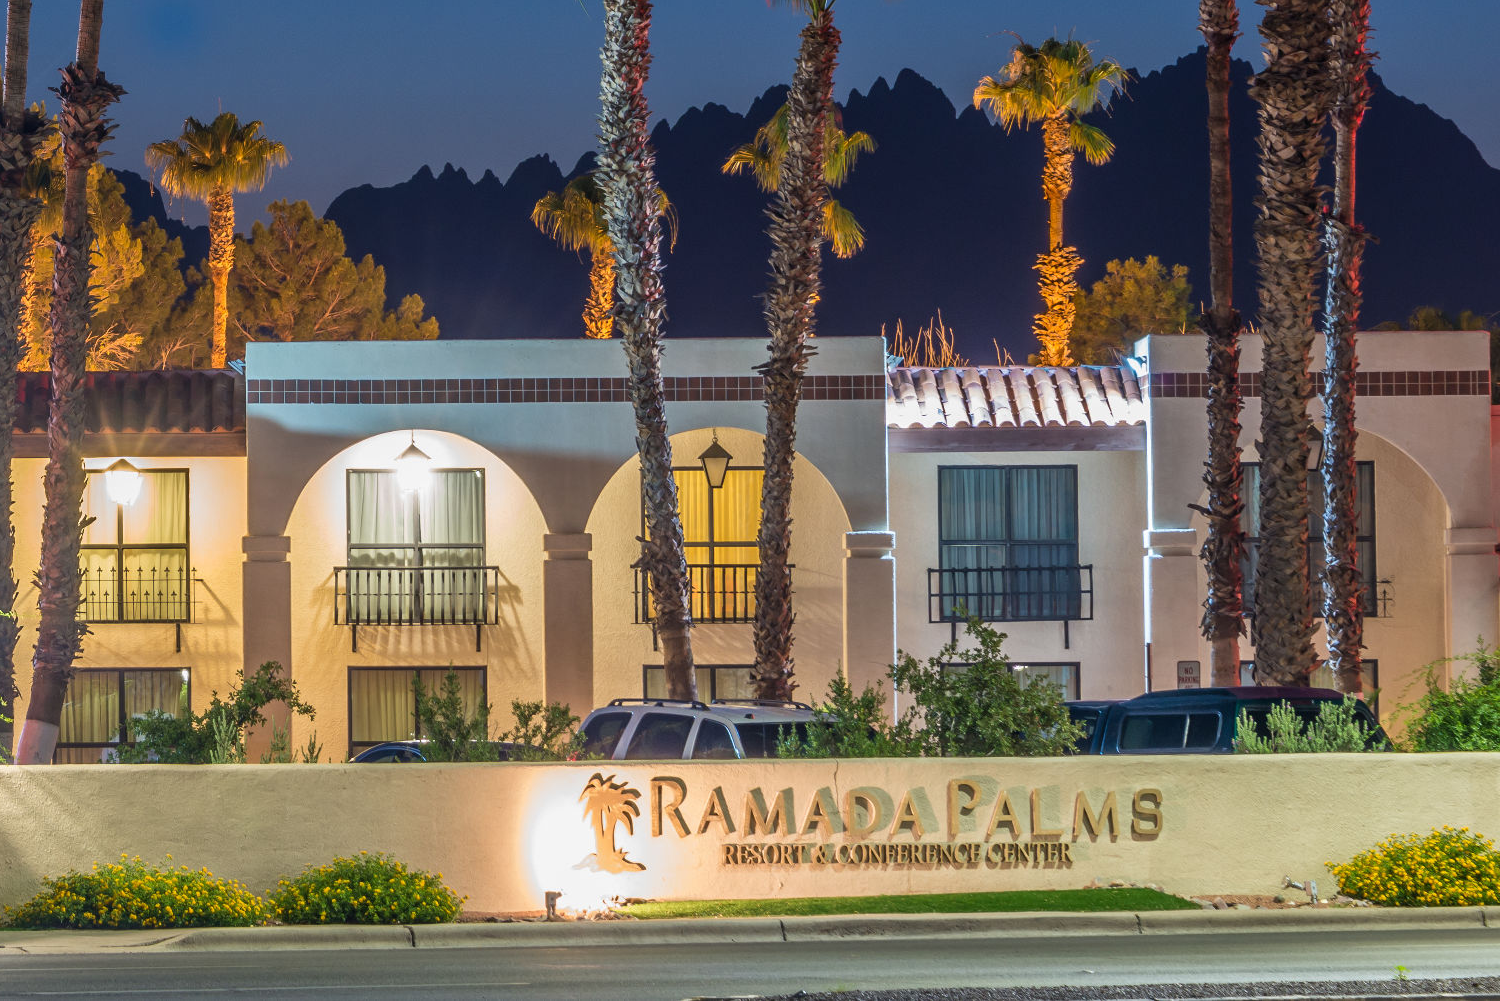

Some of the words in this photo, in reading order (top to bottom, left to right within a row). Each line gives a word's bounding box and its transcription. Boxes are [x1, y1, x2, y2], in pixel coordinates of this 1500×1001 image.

[1184, 666, 1193, 675] NO
[650, 776, 925, 839] RAMADA
[948, 779, 1163, 838] PALMS
[722, 844, 806, 865] RESORT
[810, 845, 827, 865] &
[835, 843, 981, 864] CONFERENCE
[986, 842, 1074, 863] CENTER
